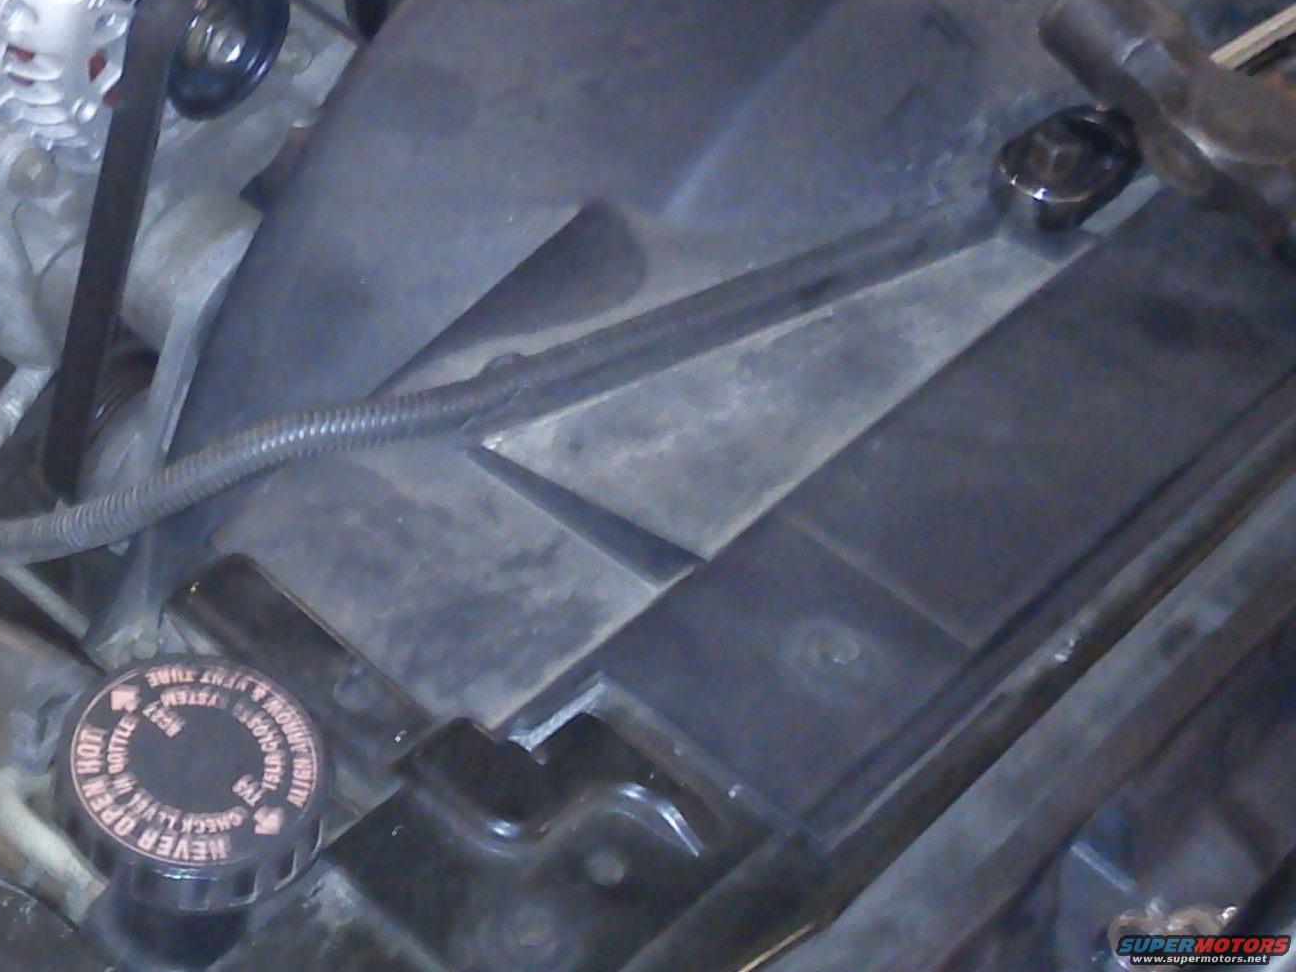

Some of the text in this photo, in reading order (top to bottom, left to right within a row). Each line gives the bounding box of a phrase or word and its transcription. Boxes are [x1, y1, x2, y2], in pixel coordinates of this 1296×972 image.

[76, 725, 233, 862] NEVER OPEN HOT
